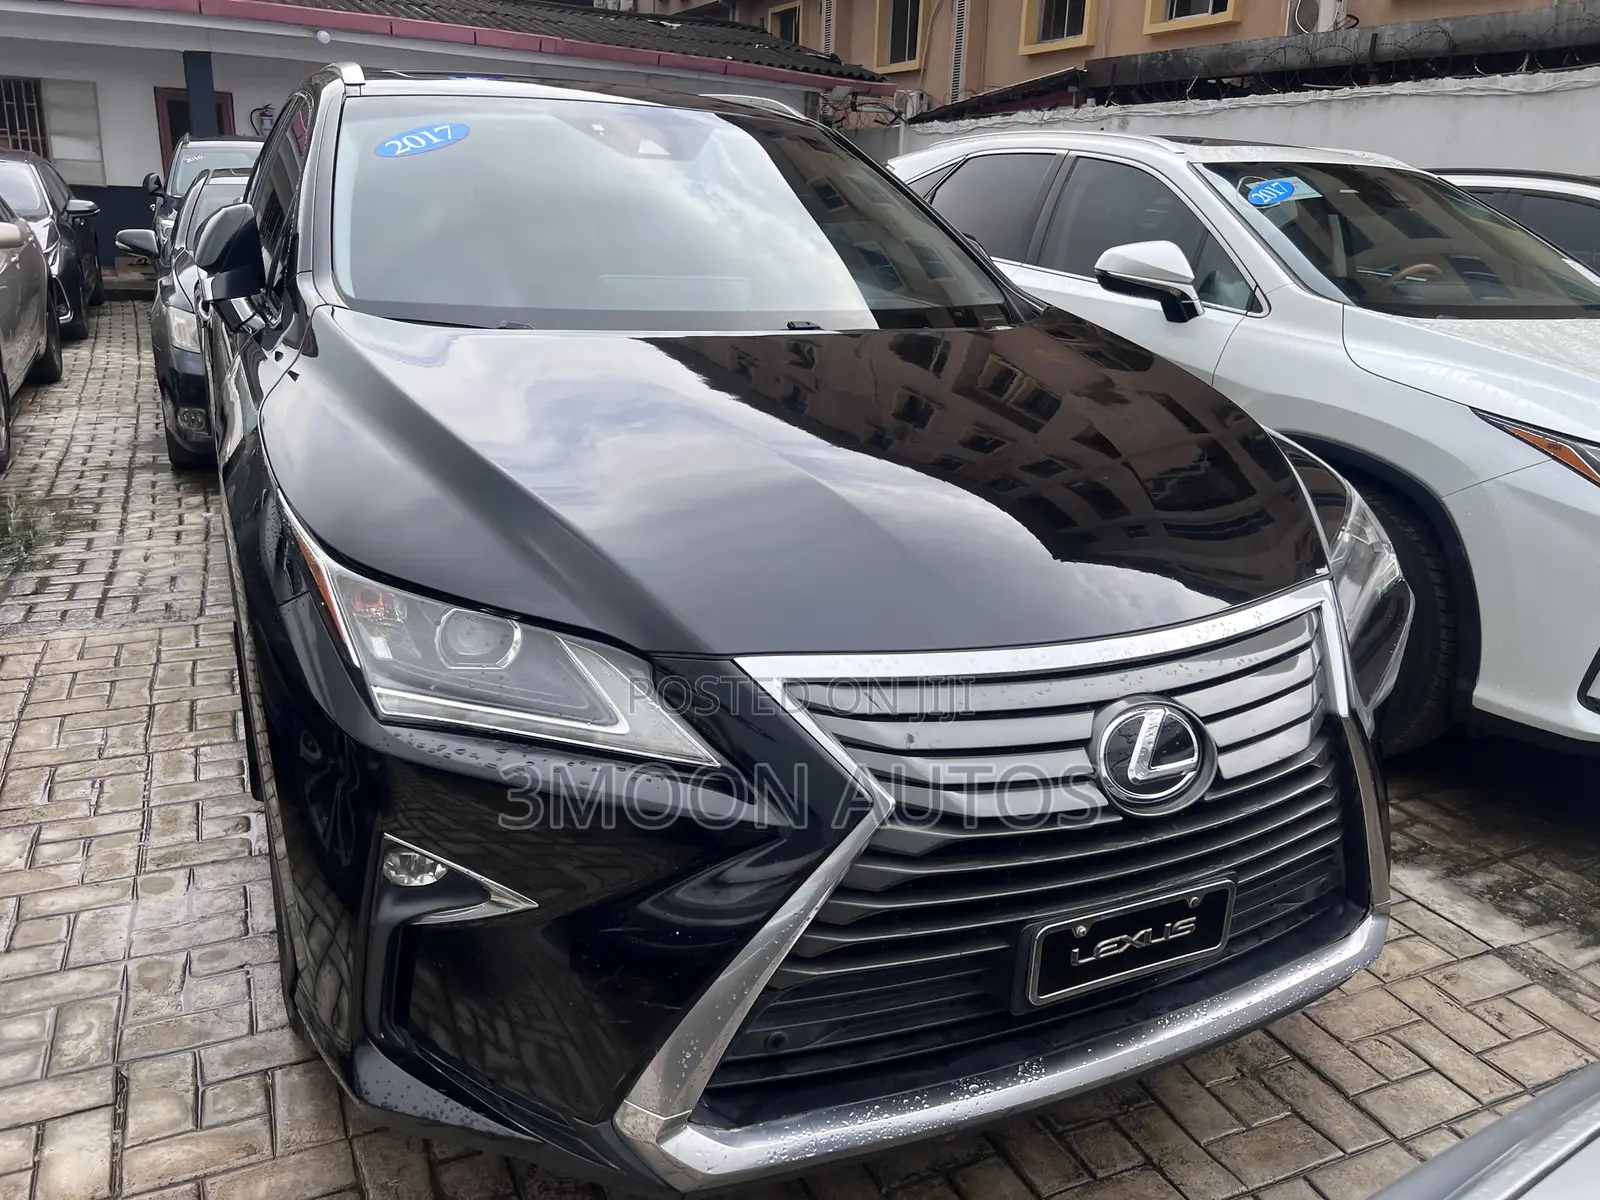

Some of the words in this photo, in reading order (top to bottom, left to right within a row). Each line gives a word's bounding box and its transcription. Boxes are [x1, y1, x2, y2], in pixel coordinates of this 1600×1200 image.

[384, 124, 452, 155] 2017
[1251, 181, 1288, 203] 2017
[1070, 916, 1197, 967] LEXUS
